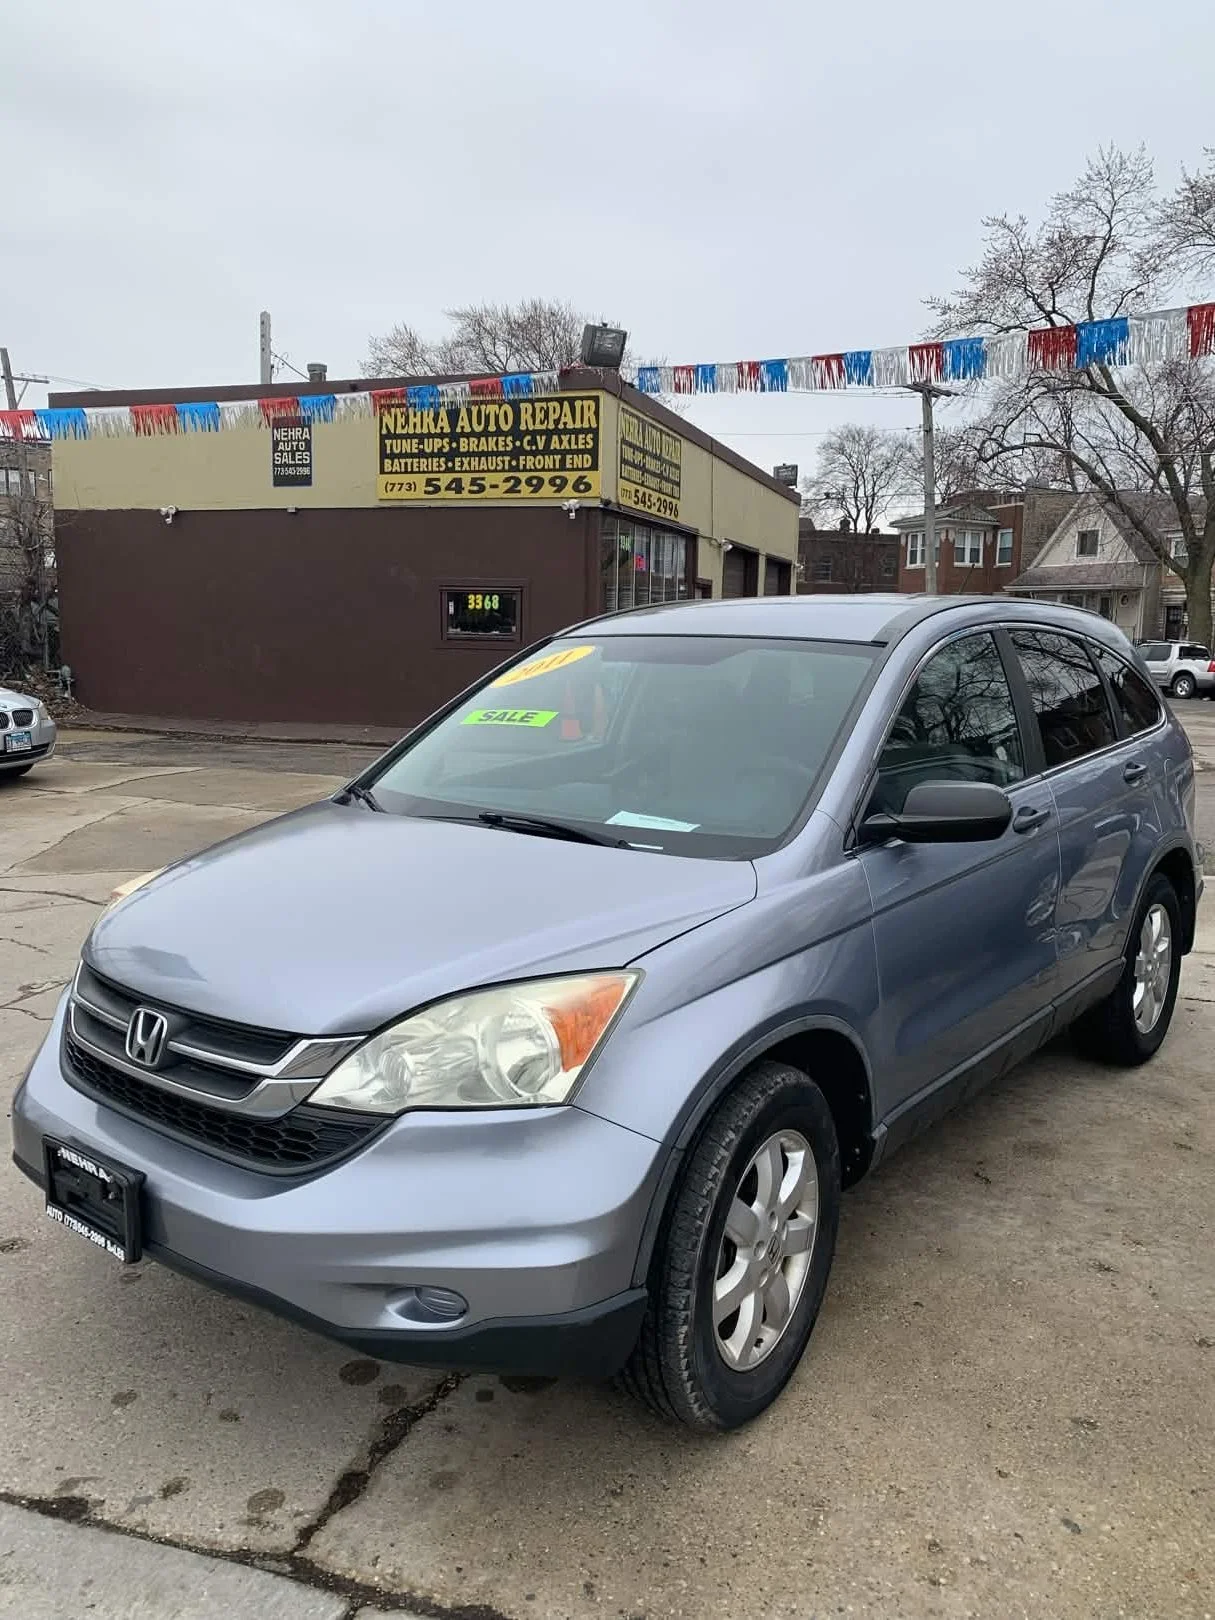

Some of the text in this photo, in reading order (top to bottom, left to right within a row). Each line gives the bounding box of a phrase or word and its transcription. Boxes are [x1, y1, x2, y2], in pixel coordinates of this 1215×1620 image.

[382, 400, 598, 434] NEHRA AUTO REPAIR
[273, 427, 310, 441] NEHRA
[278, 441, 306, 451] AUTO
[384, 438, 450, 454] TUNE-UPS
[459, 435, 514, 452] BRAKES
[550, 433, 594, 450] AXLES
[274, 451, 311, 465] SALES
[384, 454, 592, 472] BATTERIES EXHAUST FRONT END
[384, 475, 593, 496] (773) 545-2996
[633, 488, 679, 519] 545-2996
[467, 594, 500, 610] 3368
[478, 710, 538, 723] SALE
[59, 1147, 112, 1183] NEHRA
